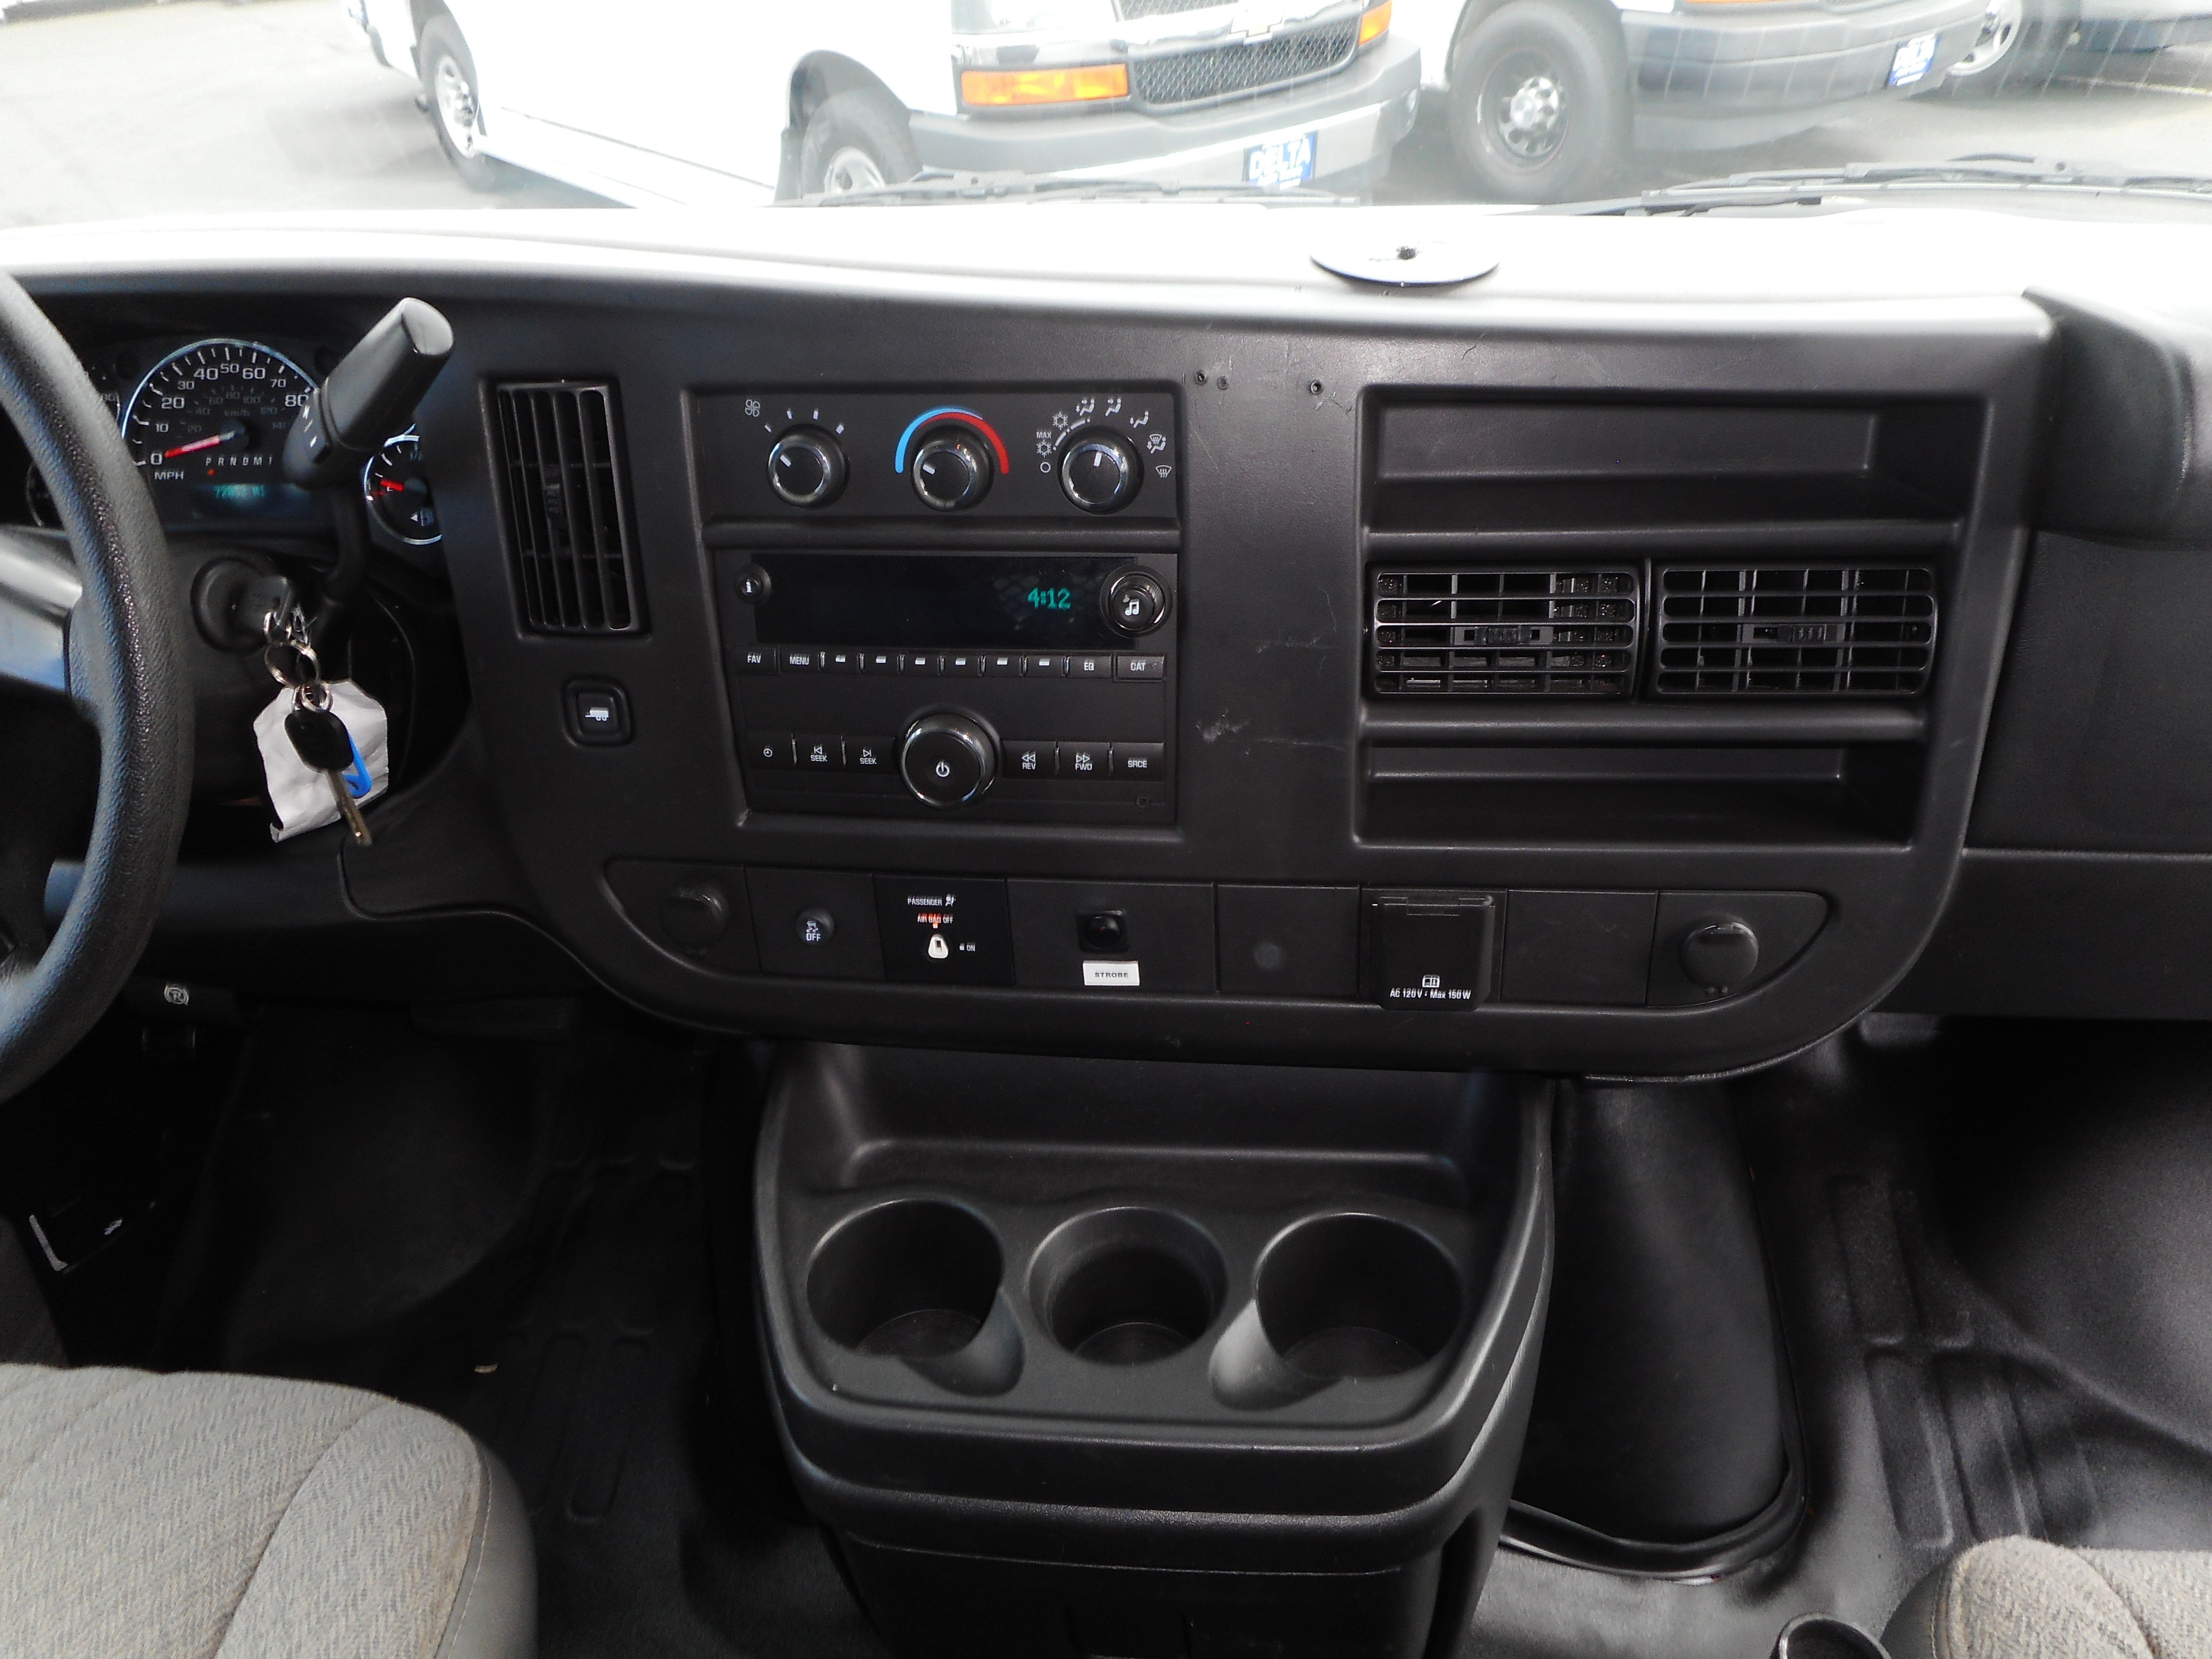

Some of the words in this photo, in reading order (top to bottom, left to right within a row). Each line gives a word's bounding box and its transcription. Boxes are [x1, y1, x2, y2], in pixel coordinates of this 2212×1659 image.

[1249, 137, 1311, 179] DELTA
[220, 364, 239, 373] 50
[194, 368, 219, 380] 40
[242, 368, 266, 379] 60
[178, 381, 194, 390] 30
[270, 379, 286, 388] 70
[161, 398, 185, 409] 20
[285, 395, 309, 407] 80
[155, 423, 169, 432] 10
[151, 453, 162, 465] 0
[155, 471, 184, 480] MPH
[1028, 587, 1071, 609] 4:12
[747, 655, 761, 663] FAV
[789, 656, 809, 665] MENU
[1084, 662, 1094, 671] EQ
[1130, 662, 1146, 671] CAT
[1127, 760, 1147, 768] SRCE
[908, 898, 942, 906] PASSENGER
[806, 933, 821, 942] OFF
[1390, 989, 1401, 997] AC
[1430, 989, 1446, 999] Max
[1448, 990, 1471, 999] 150W
